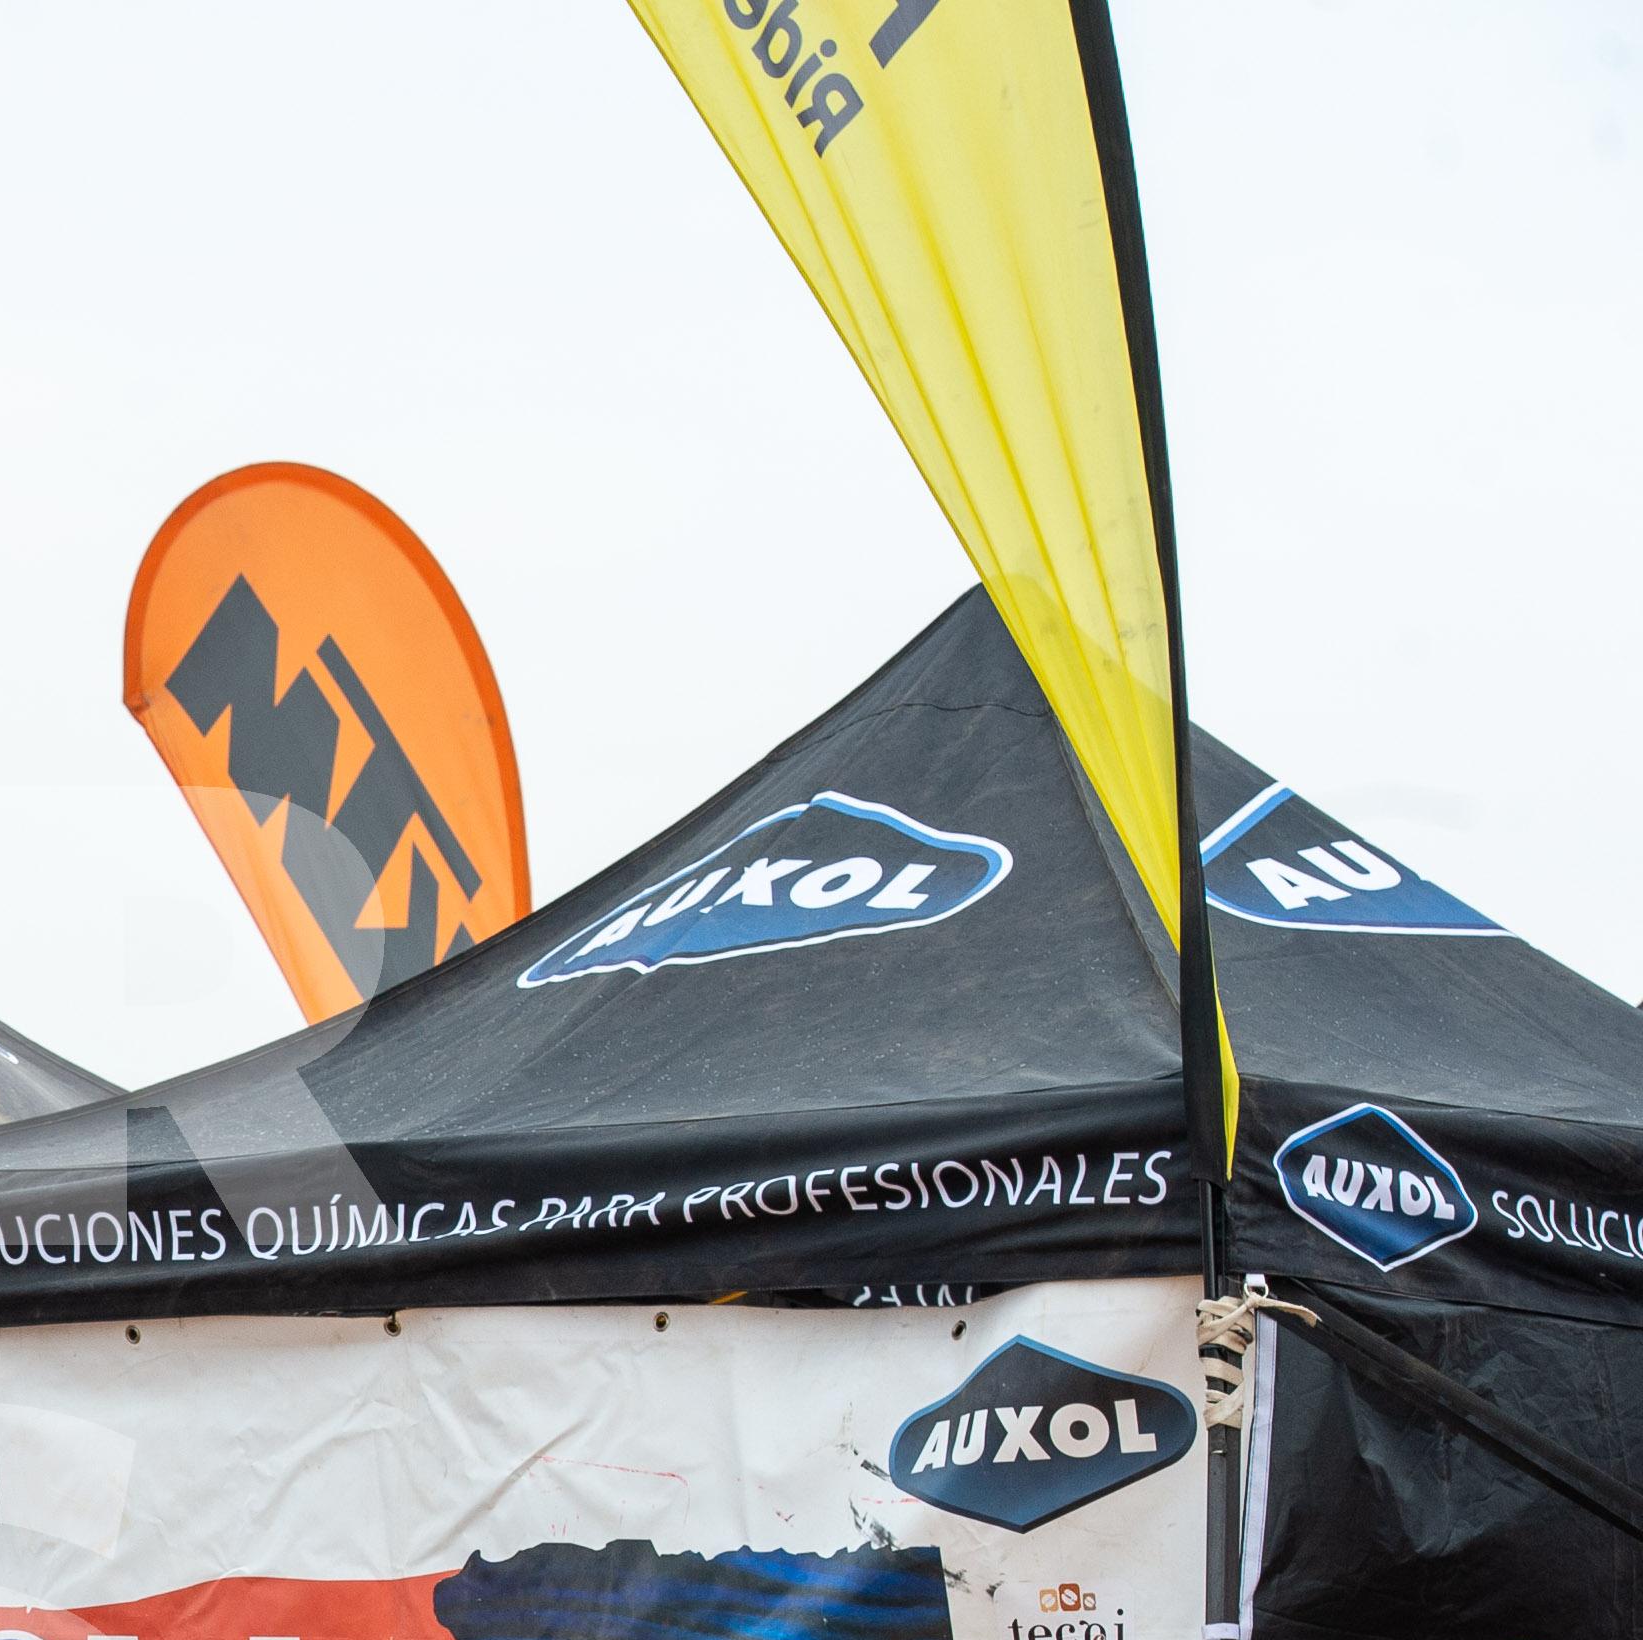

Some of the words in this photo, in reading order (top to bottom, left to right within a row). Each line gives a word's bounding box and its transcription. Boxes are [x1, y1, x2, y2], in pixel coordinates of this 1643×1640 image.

[565, 855, 939, 963] AUXOL
[1246, 840, 1402, 910] AU
[248, 1194, 515, 1261] QUÍMICAS
[519, 1191, 665, 1232] PARA
[683, 1150, 1172, 1223] PROFESIONALES
[1301, 1154, 1456, 1220] AUXOL
[911, 1398, 1158, 1474] AUXOL
